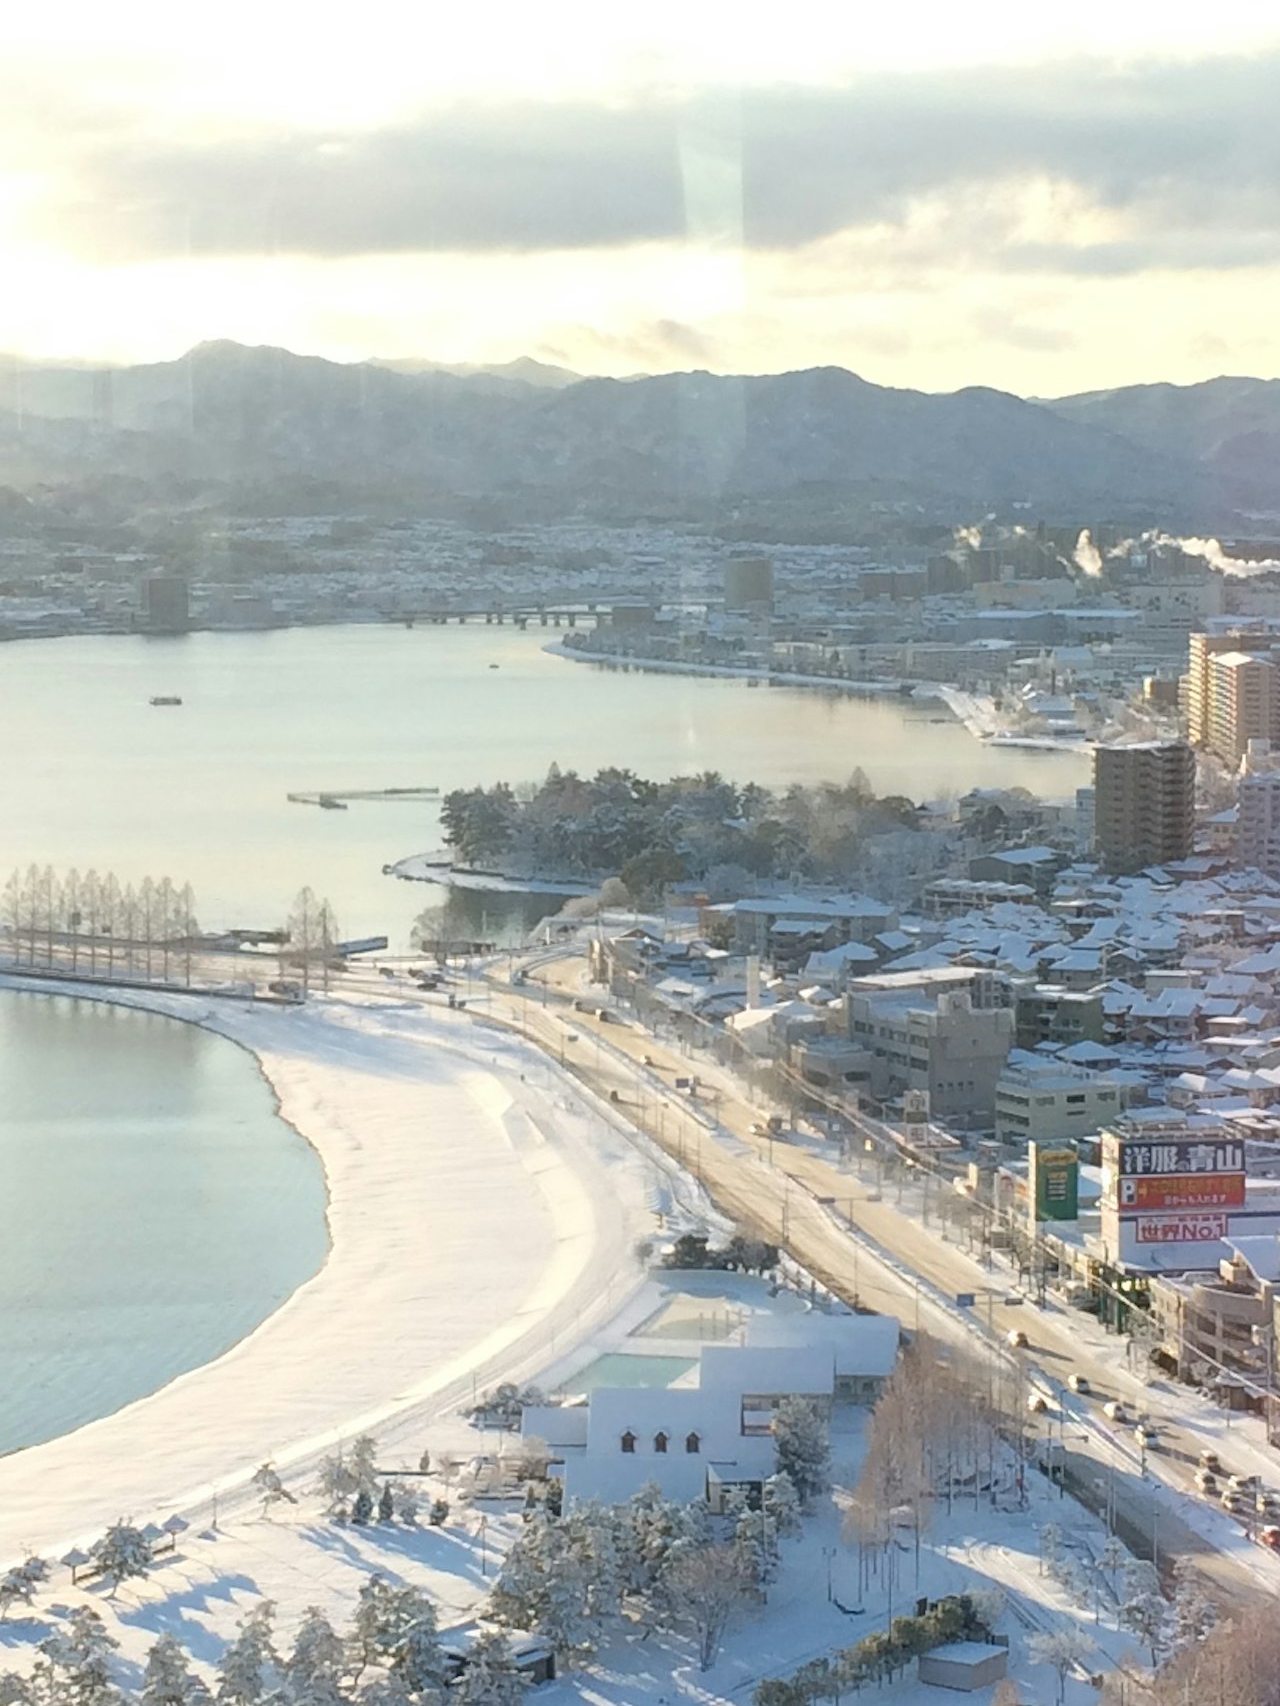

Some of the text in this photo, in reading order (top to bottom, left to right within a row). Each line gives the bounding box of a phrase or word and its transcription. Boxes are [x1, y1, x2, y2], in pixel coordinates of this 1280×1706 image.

[1124, 1144, 1242, 1173] 洋服の青山
[1141, 1223, 1225, 1240] 世界No.1
